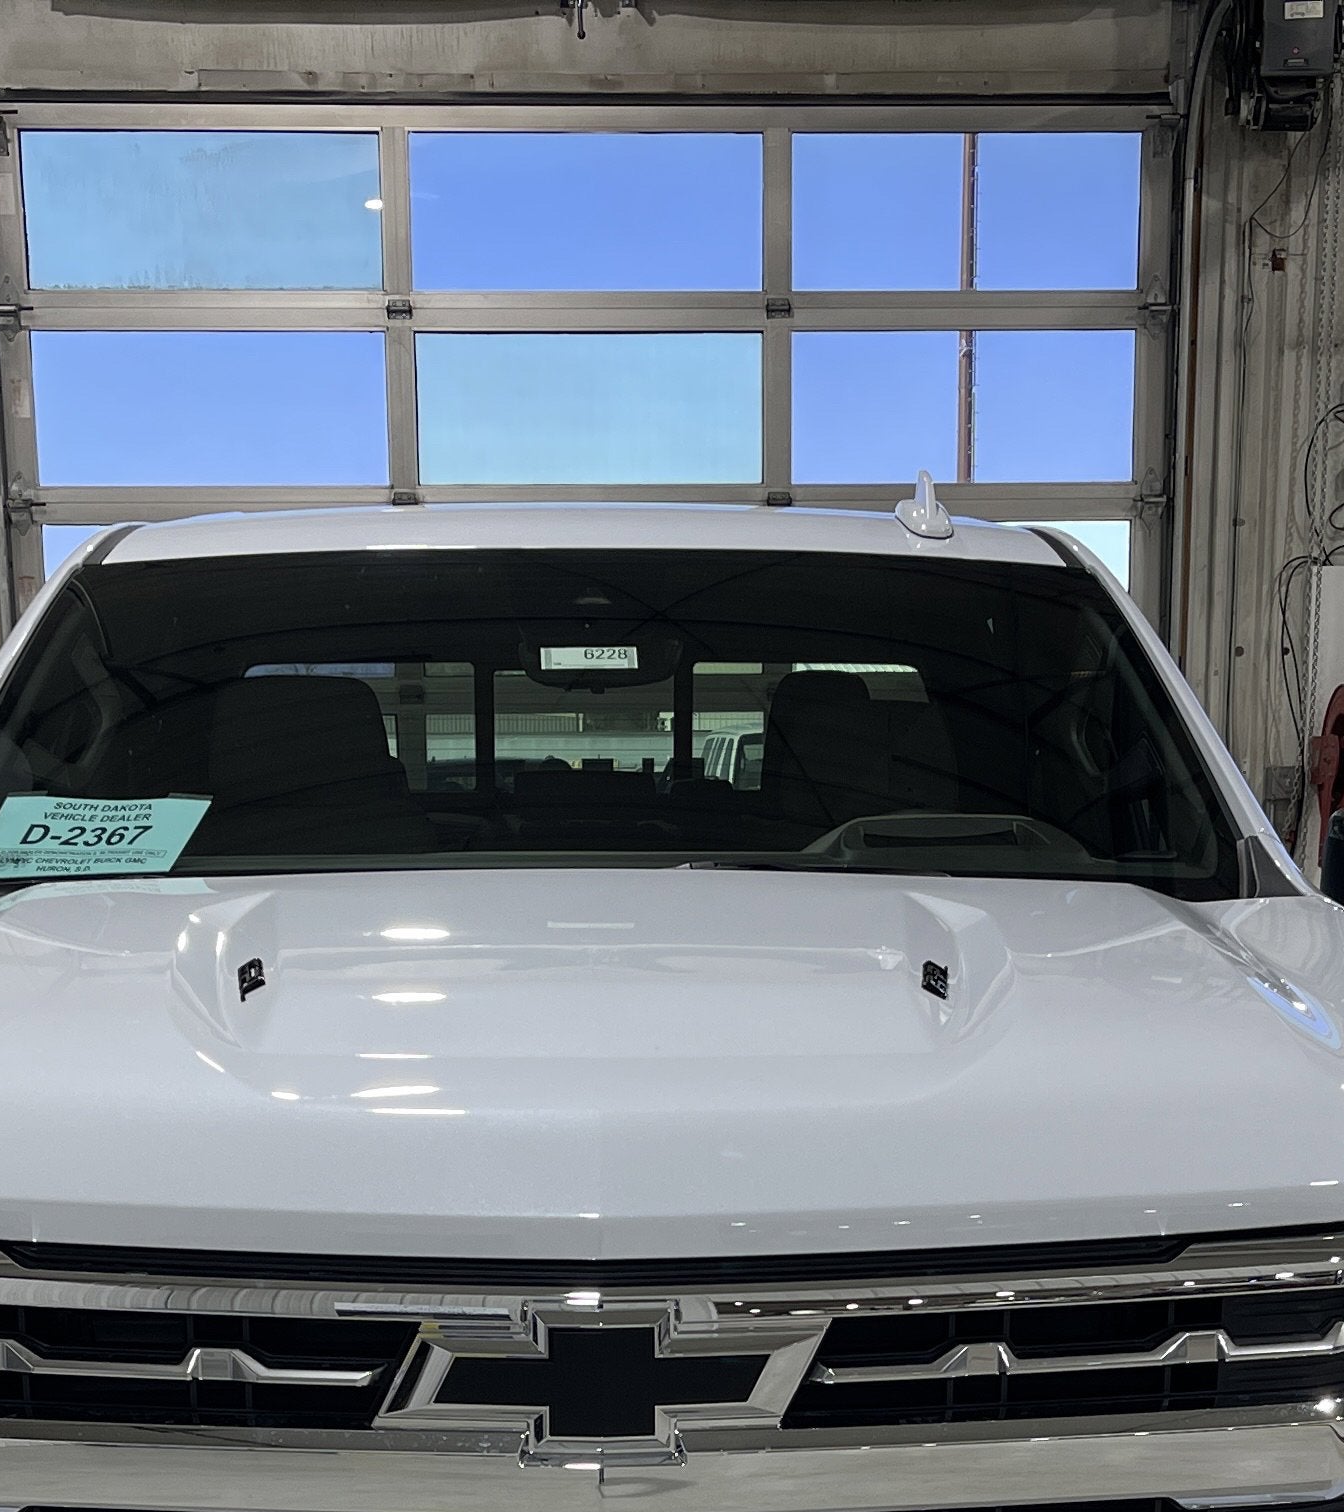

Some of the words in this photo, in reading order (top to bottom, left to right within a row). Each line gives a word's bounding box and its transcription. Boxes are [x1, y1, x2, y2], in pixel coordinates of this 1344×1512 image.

[583, 648, 628, 660] 6228
[54, 802, 99, 812] SOUTH
[101, 803, 153, 812] DAKOTA
[44, 812, 98, 822] VEHICLE
[100, 813, 153, 822] DEALER
[19, 824, 154, 848] D-2367
[35, 857, 92, 865] CHEVROLET
